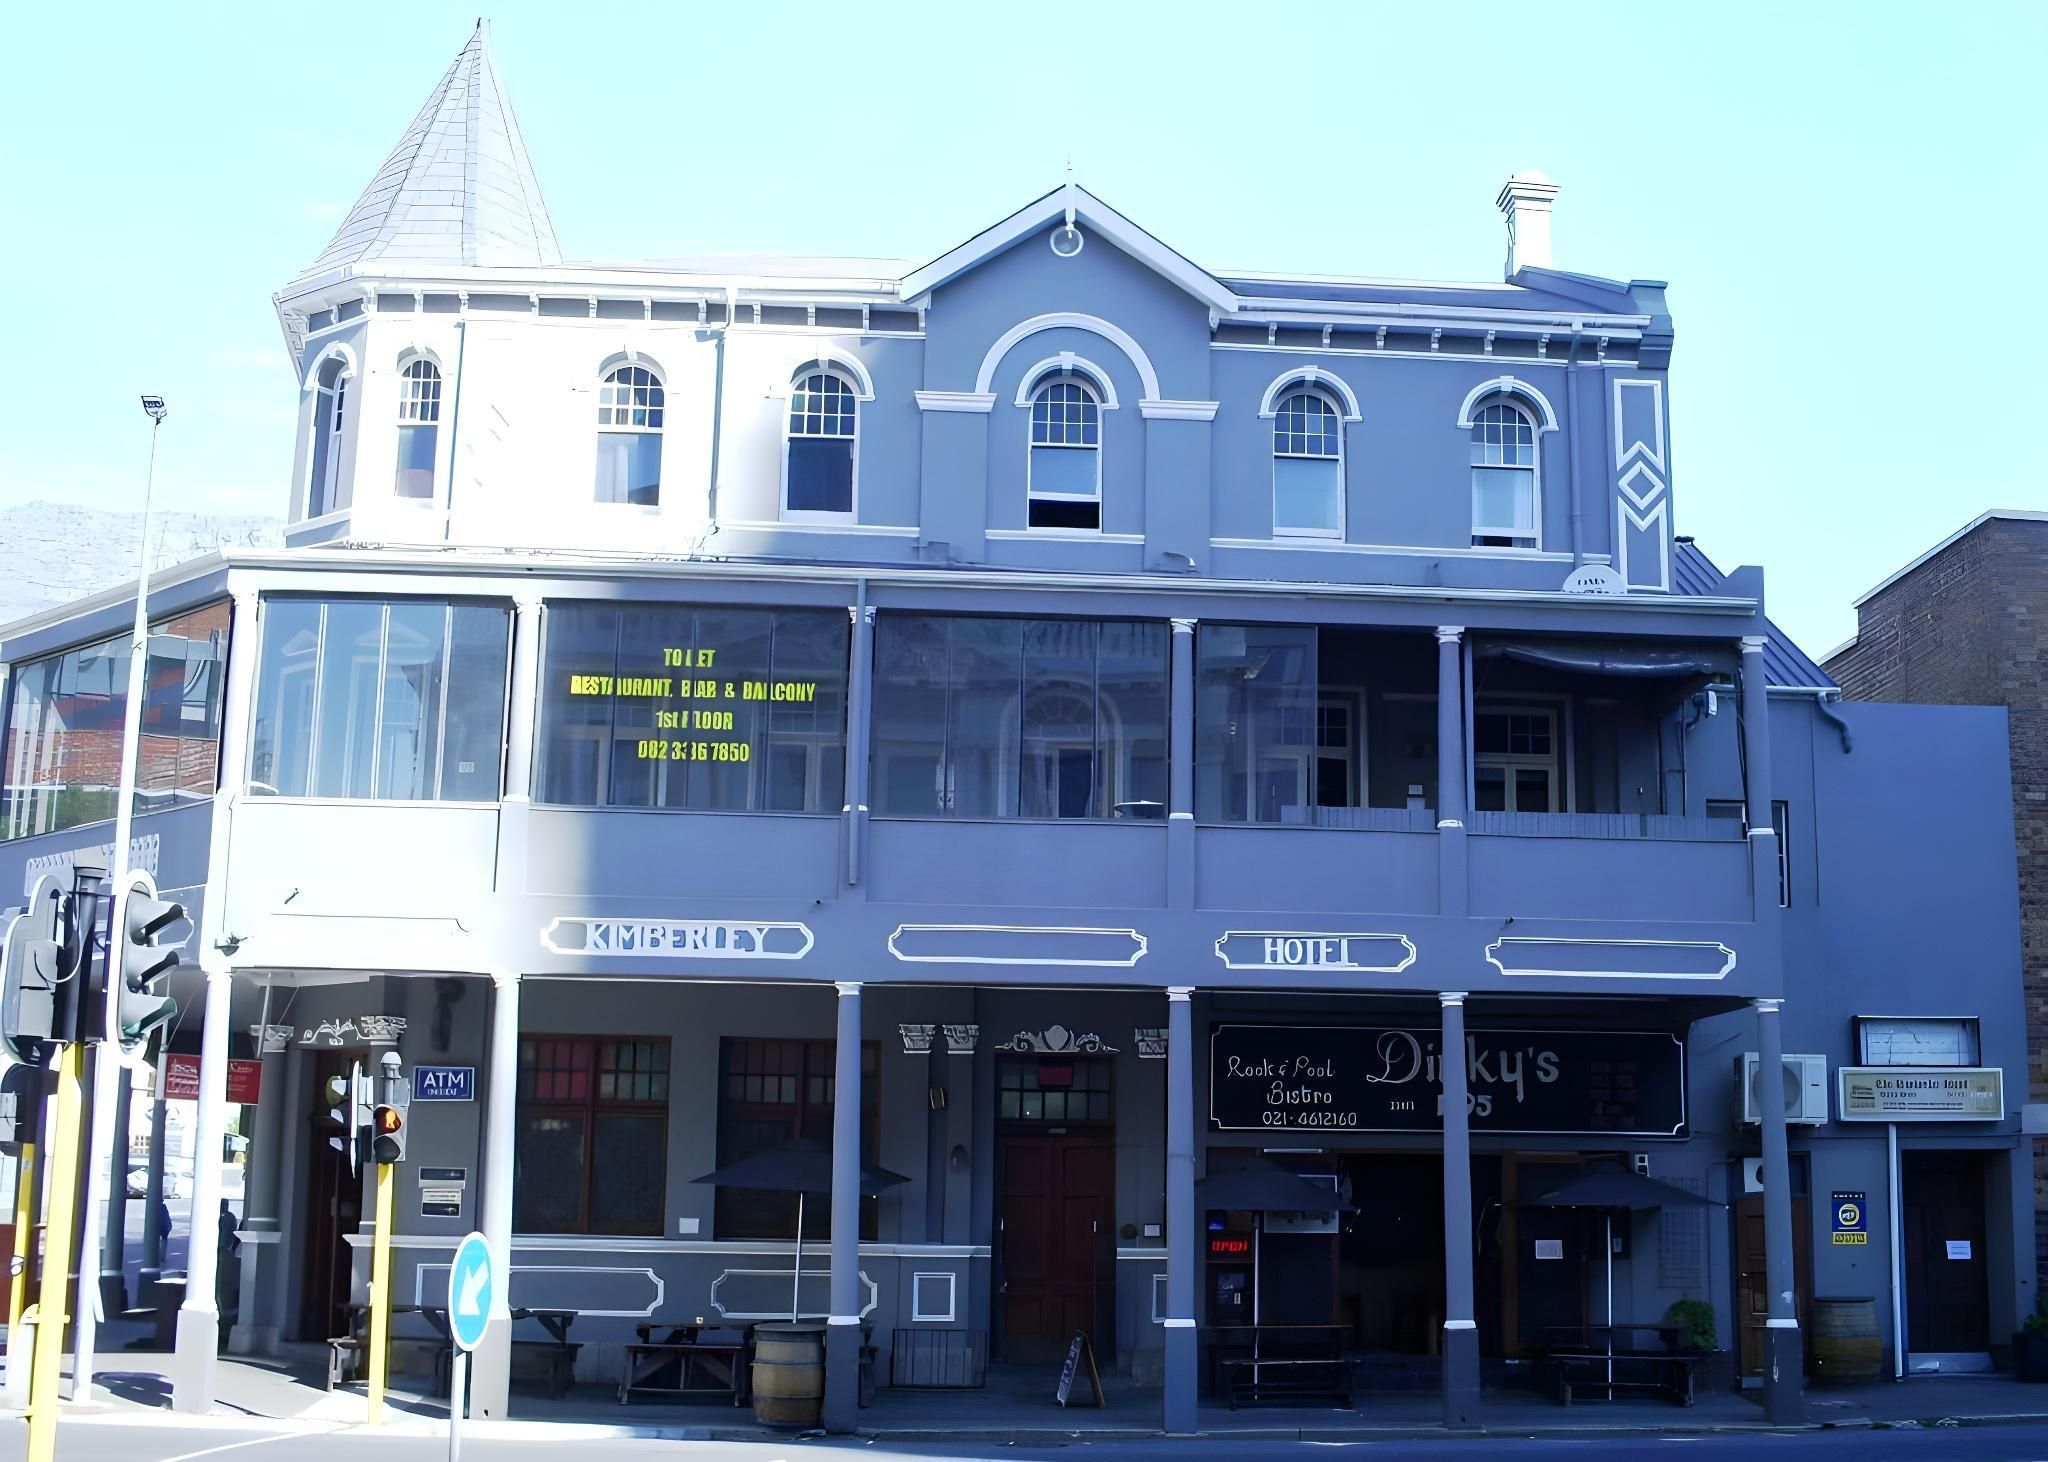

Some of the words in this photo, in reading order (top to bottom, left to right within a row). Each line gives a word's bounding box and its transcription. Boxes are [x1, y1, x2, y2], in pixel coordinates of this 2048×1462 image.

[664, 648, 683, 667] TO
[685, 648, 715, 668] LET
[681, 679, 717, 698] BAR
[724, 681, 735, 698] &
[743, 682, 816, 702] BALCONY
[681, 710, 733, 731] FLOOR
[711, 742, 750, 762] 7850
[584, 923, 770, 952] KIMBERLEY
[1264, 936, 1358, 966] HOTEL
[1292, 1055, 1336, 1078] Pool
[1366, 1031, 1560, 1103] Diky's
[423, 1071, 464, 1089] ATM
[1266, 1080, 1333, 1105] Bistro
